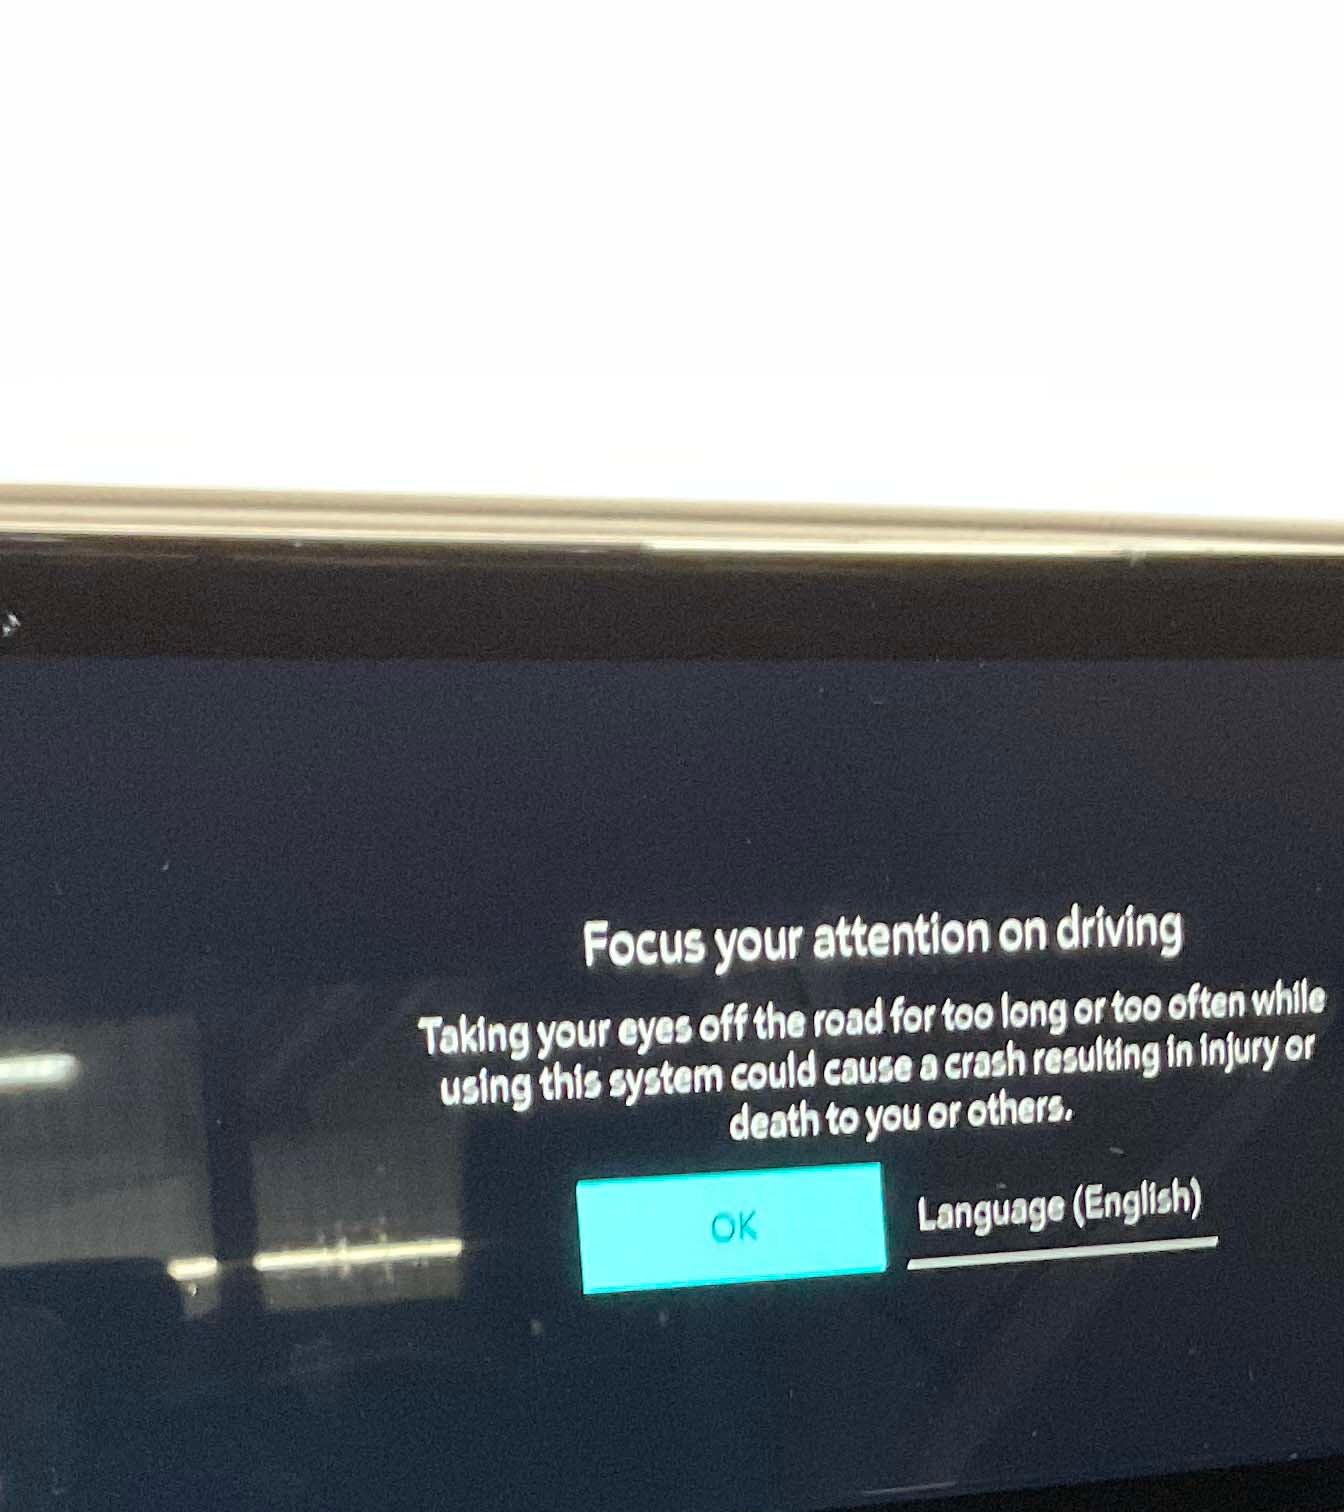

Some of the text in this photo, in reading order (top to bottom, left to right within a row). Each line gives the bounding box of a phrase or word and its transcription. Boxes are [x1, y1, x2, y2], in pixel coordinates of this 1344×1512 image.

[583, 903, 1183, 976] Focus your attention on driving
[418, 977, 1327, 1061] Taking your eyes off the road for too long or too often while
[441, 1031, 1316, 1112] using this system could cause a crash resulting in injury or
[730, 1088, 1074, 1143] death to you or others.
[711, 1210, 759, 1244] OK
[917, 1176, 1203, 1238] Language (English)
